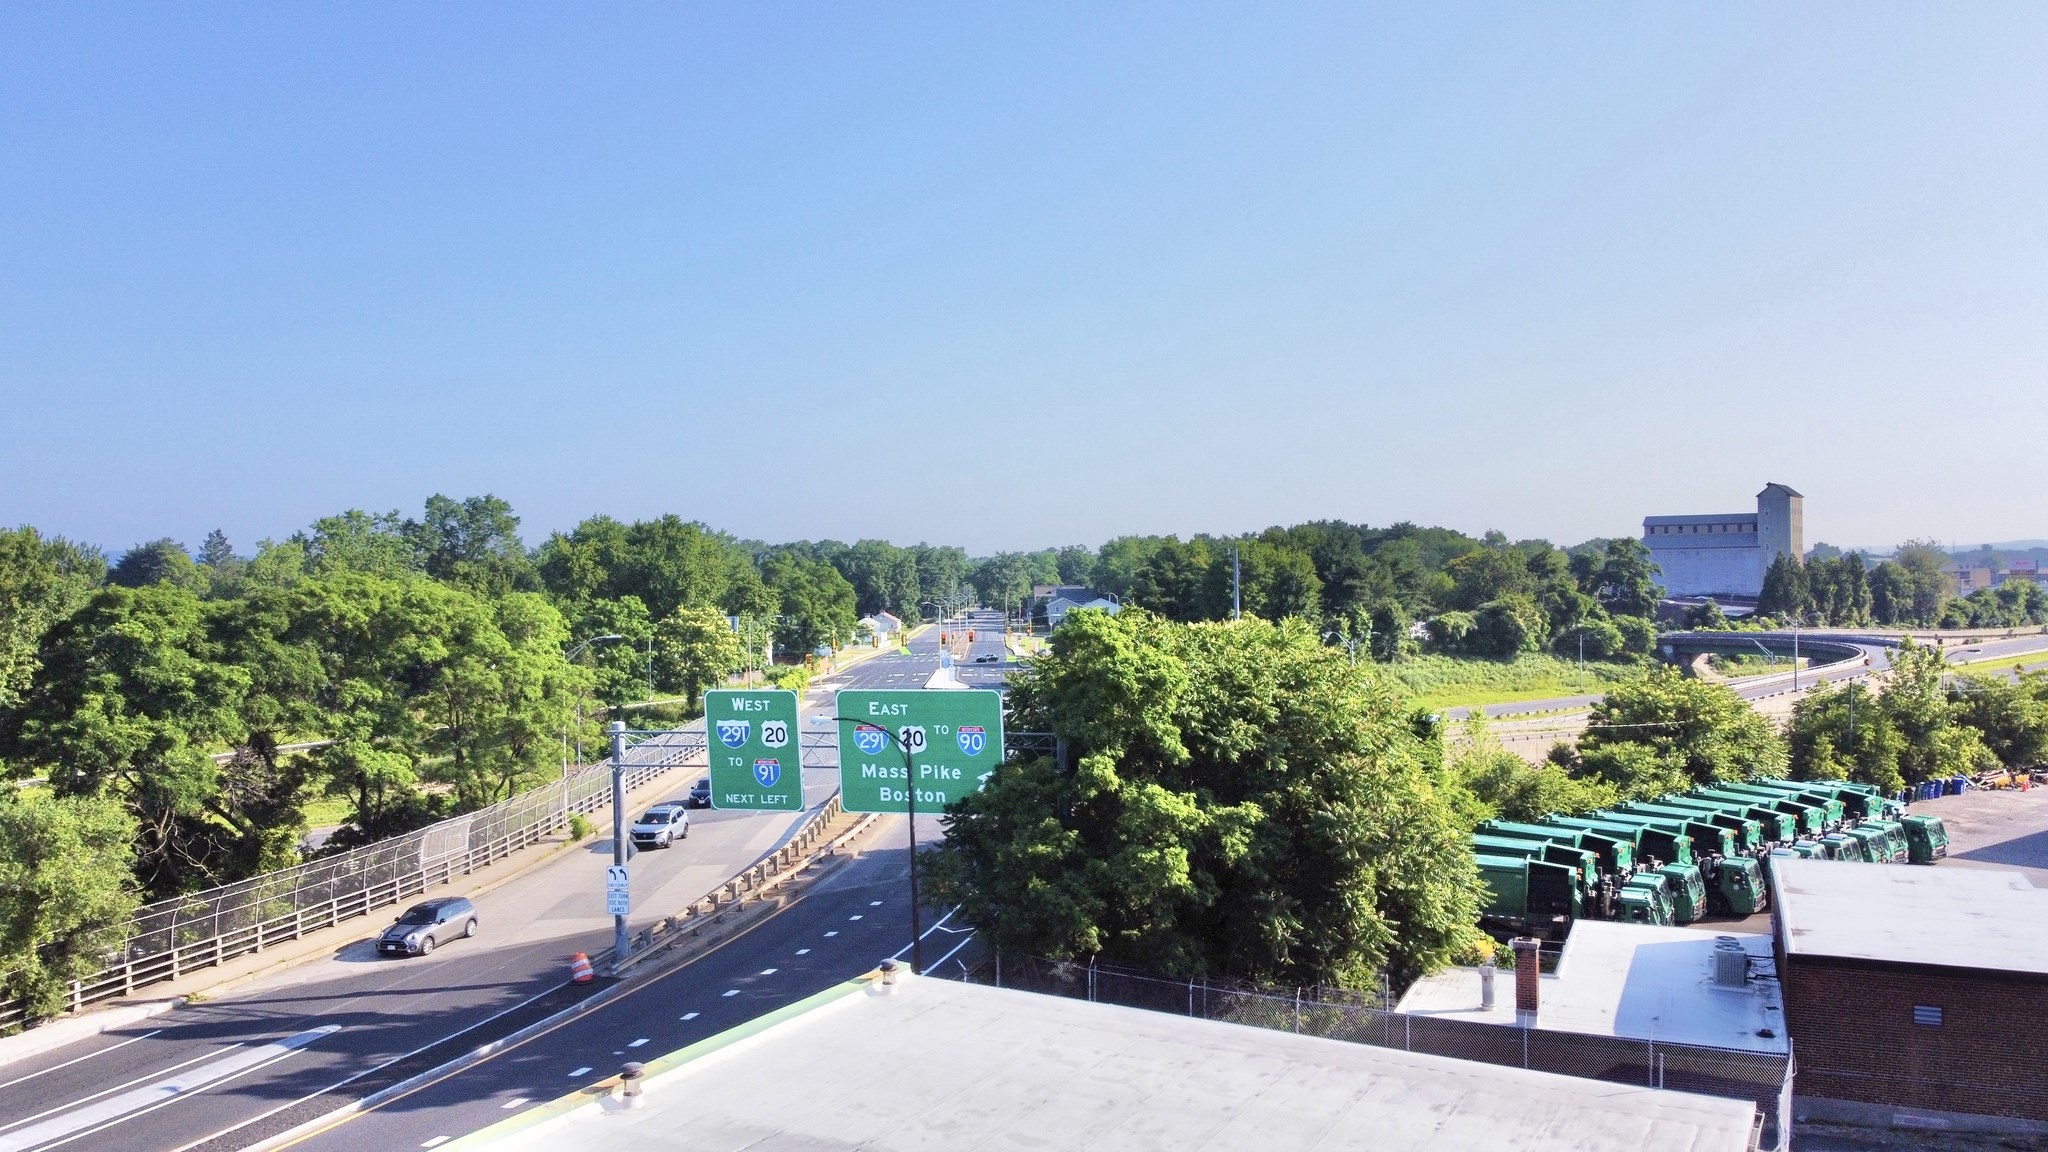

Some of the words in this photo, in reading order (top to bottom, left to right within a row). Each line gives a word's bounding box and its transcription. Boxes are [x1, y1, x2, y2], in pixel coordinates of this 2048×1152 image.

[731, 697, 771, 711] WEST
[868, 701, 909, 716] EAST
[721, 726, 746, 742] 291
[764, 727, 786, 743] 20
[933, 724, 950, 735] TO
[859, 732, 885, 749] 291
[902, 730, 924, 747] 20
[959, 733, 983, 751] 90
[728, 757, 743, 767] TO
[758, 765, 774, 781] 91
[861, 763, 910, 779] Mass
[920, 764, 962, 780] Pike
[725, 793, 755, 804] NEXT
[760, 794, 789, 805] LEFT
[879, 787, 946, 803] Boston
